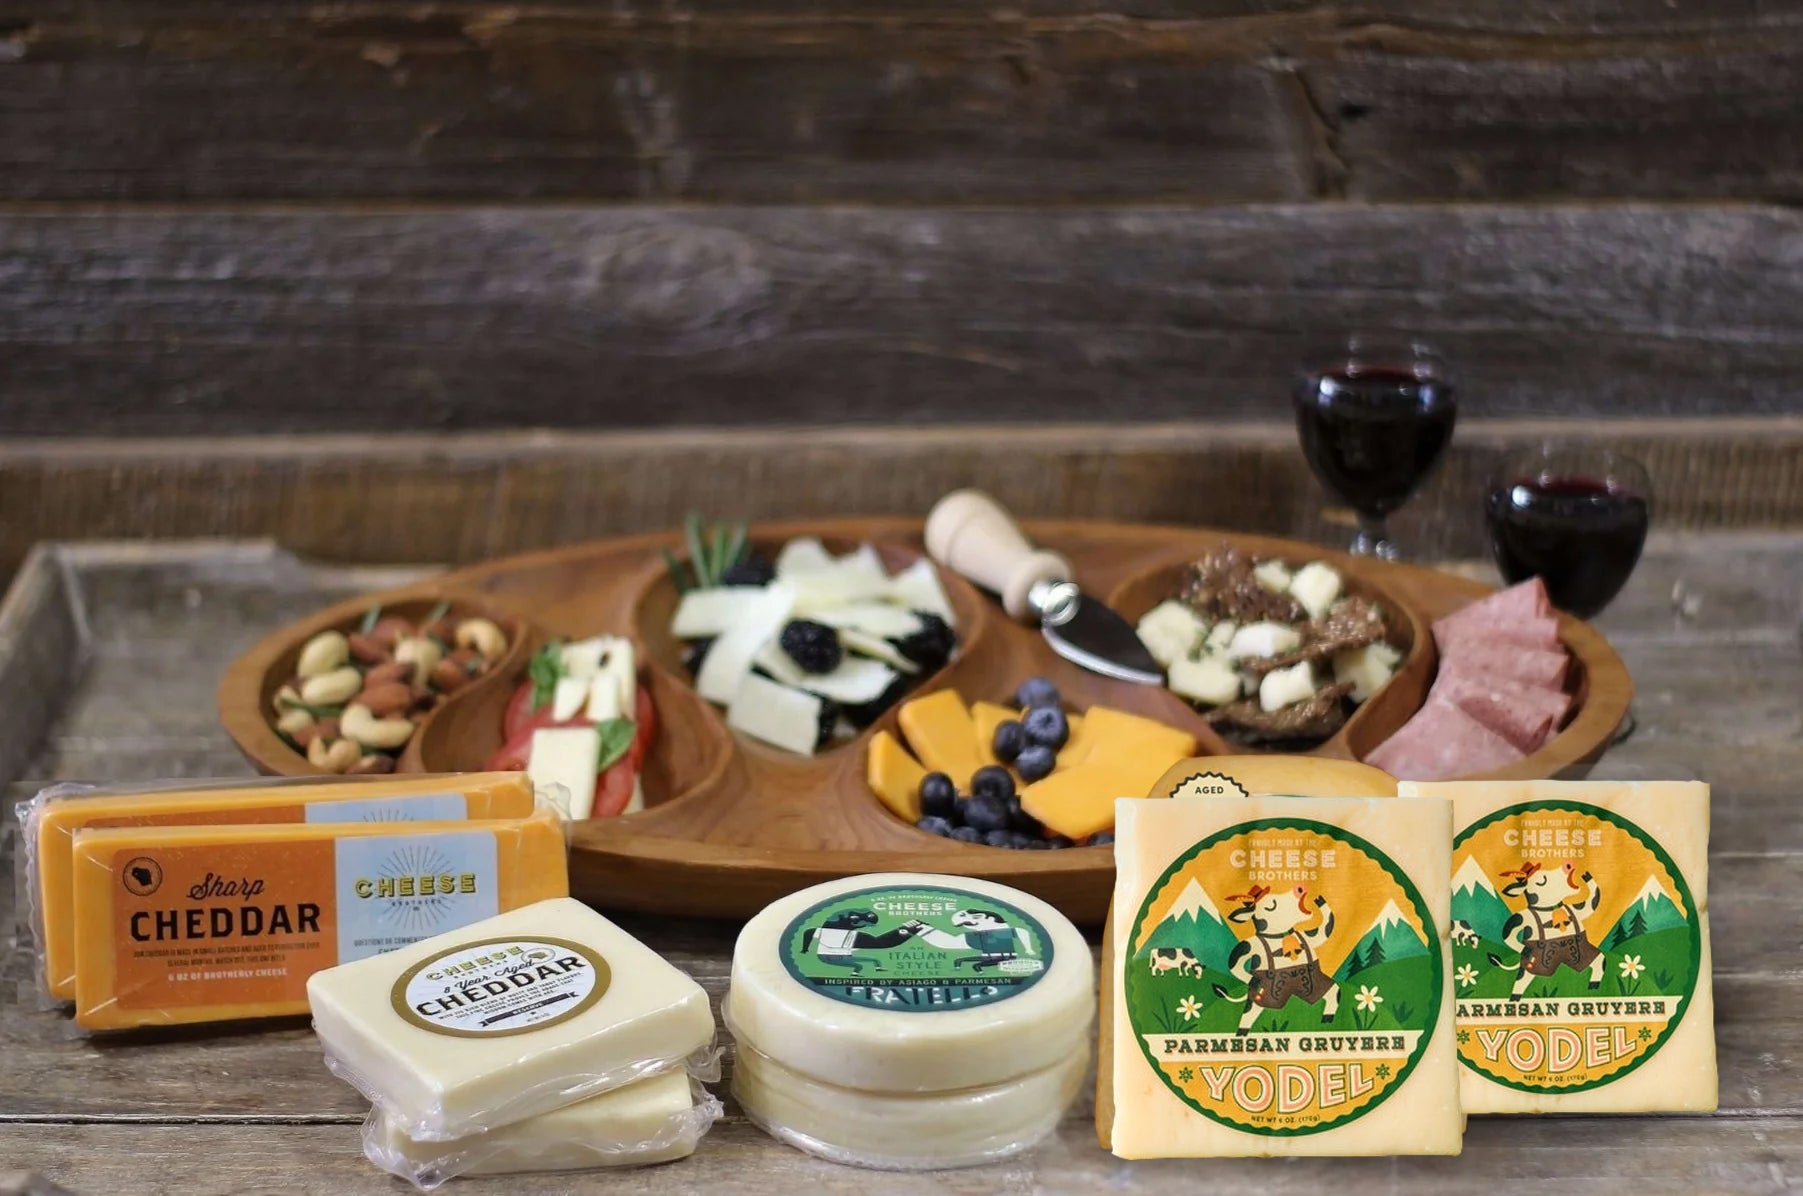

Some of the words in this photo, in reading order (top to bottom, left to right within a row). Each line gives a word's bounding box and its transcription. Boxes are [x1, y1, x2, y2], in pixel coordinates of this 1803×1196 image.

[1195, 786, 1224, 795] AGED
[1503, 829, 1602, 846] CHEESE
[1230, 850, 1336, 868] CHEESE
[1521, 848, 1585, 858] BROTHERS
[1249, 870, 1318, 881] BROTHERS
[186, 872, 264, 901] Sharp
[355, 872, 476, 898] CHEESE
[873, 902, 957, 911] CHEESE
[130, 903, 321, 941] CHEDDAR
[426, 945, 524, 981] CHEESE
[889, 952, 946, 960] ITALIAN
[896, 961, 942, 969] STYLE
[204, 970, 253, 980] BROTHERLY
[255, 968, 288, 977] CHEESE
[444, 986, 451, 994] 8
[454, 975, 491, 990] Year
[494, 959, 534, 977] Aged
[415, 956, 586, 1016] CHEDDAR
[846, 986, 998, 1005] FRATELLO
[1456, 1002, 1559, 1017] ARMESAN
[1567, 1000, 1666, 1015] GRUYERE
[1164, 1037, 1290, 1054] PARMESAN
[1299, 1036, 1405, 1051] GRUYERE
[1476, 1026, 1637, 1073] YODEL
[1199, 1063, 1374, 1114] YODEL
